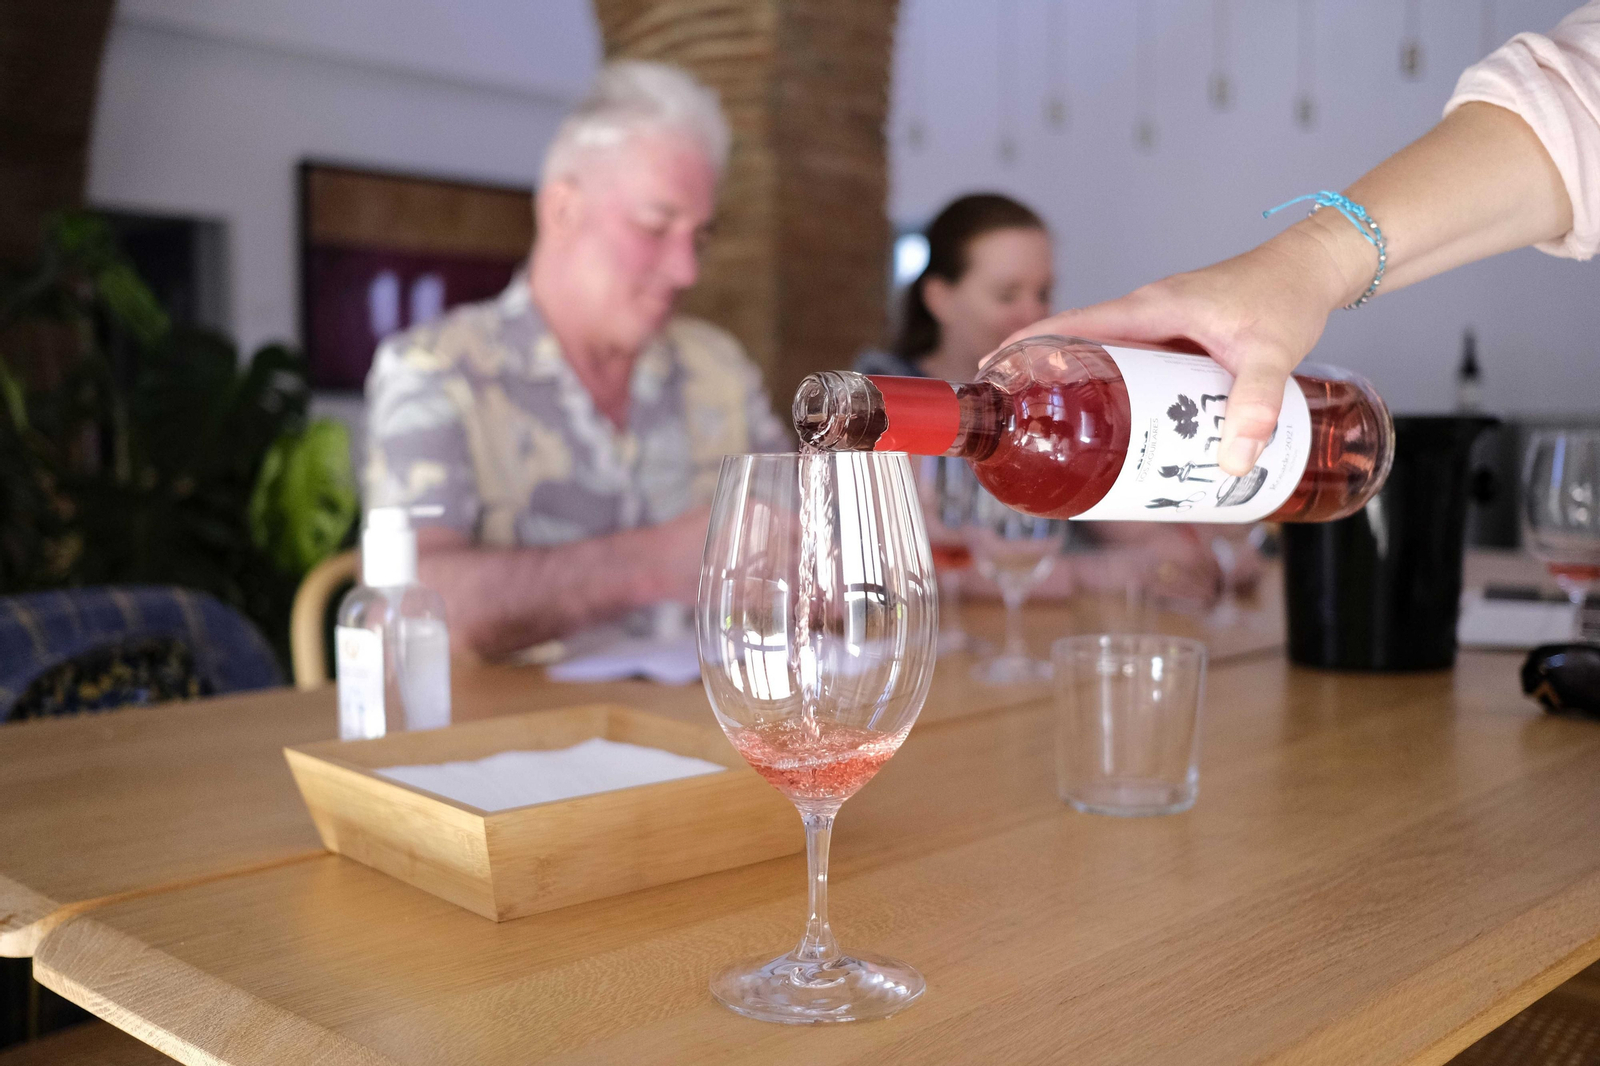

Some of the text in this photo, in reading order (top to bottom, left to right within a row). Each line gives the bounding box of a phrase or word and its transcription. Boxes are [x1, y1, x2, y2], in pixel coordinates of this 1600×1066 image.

[1138, 417, 1159, 482] LOS AGUILARES
[1285, 424, 1294, 451] 2021
